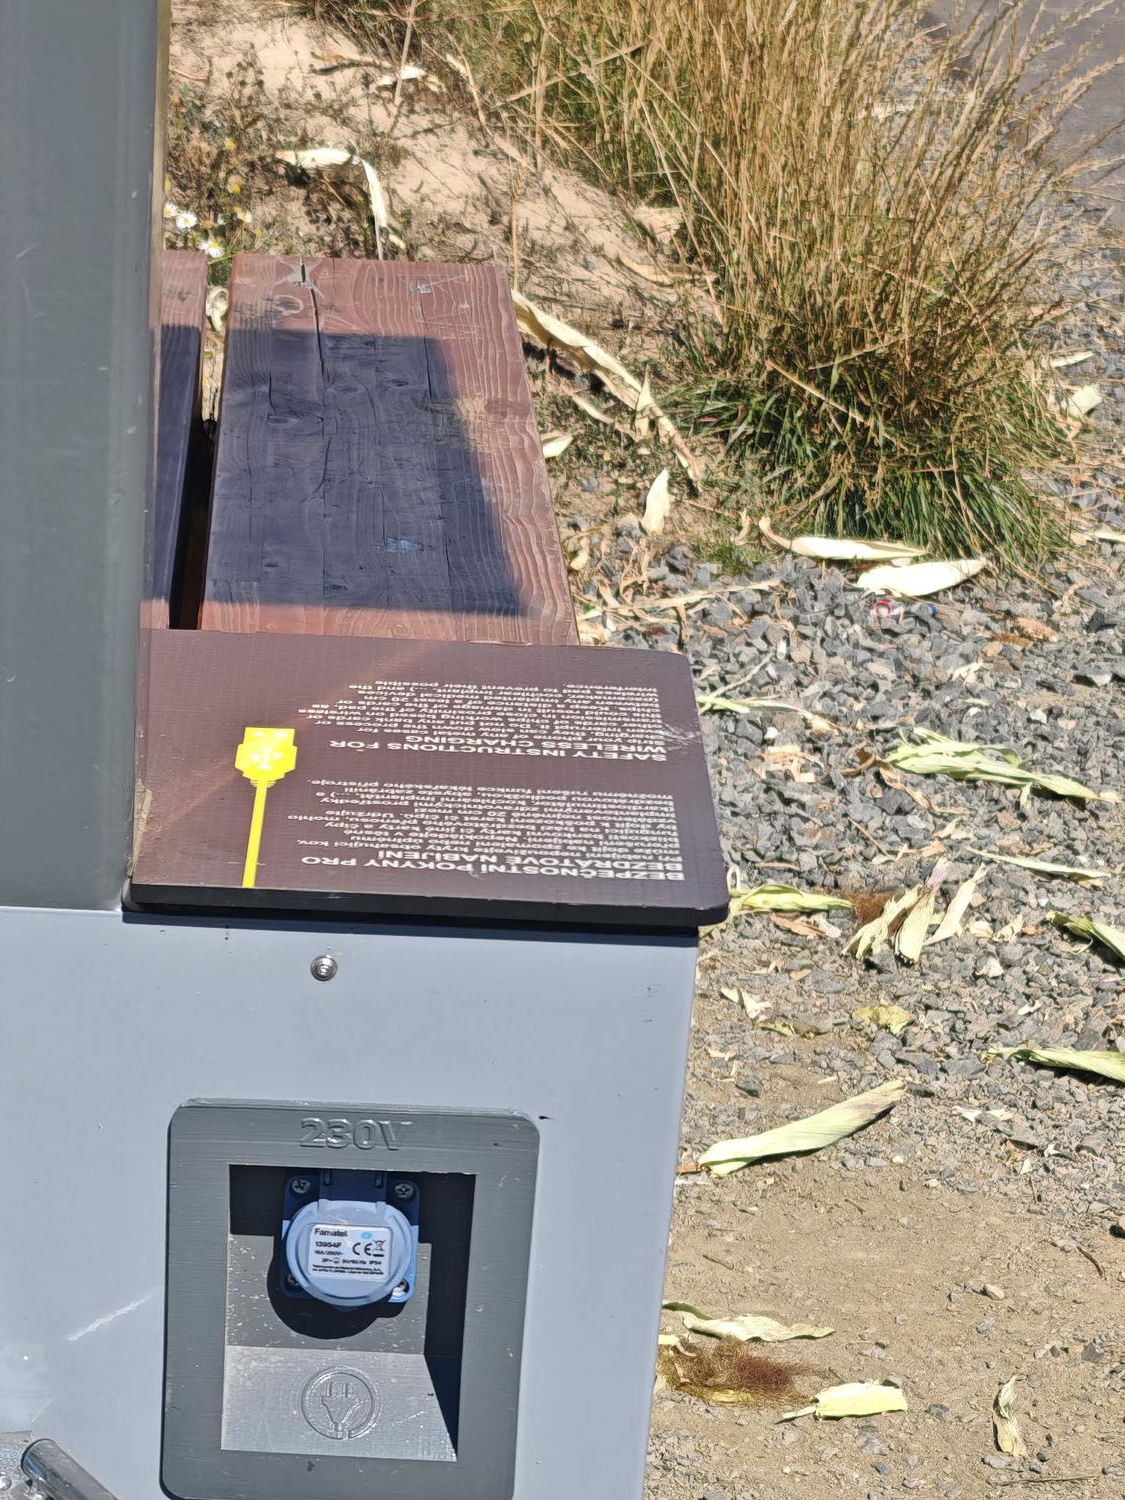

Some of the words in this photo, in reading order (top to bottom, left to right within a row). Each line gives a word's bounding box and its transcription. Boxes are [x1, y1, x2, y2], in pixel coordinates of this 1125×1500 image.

[329, 740, 379, 748] FOR
[404, 735, 533, 747] CHARGING
[541, 740, 666, 753] WIRELESS
[386, 742, 565, 756] INSTRUCTIONS
[572, 750, 667, 761] SAFETY
[301, 855, 356, 866] PRO
[378, 849, 497, 864] NABÍJENÍ
[364, 859, 473, 871] POKYNY
[505, 855, 682, 872] BEZDRÁTOVÉ
[480, 864, 684, 882] BEZPEČNOSTNÍ
[299, 1117, 414, 1150] 230V
